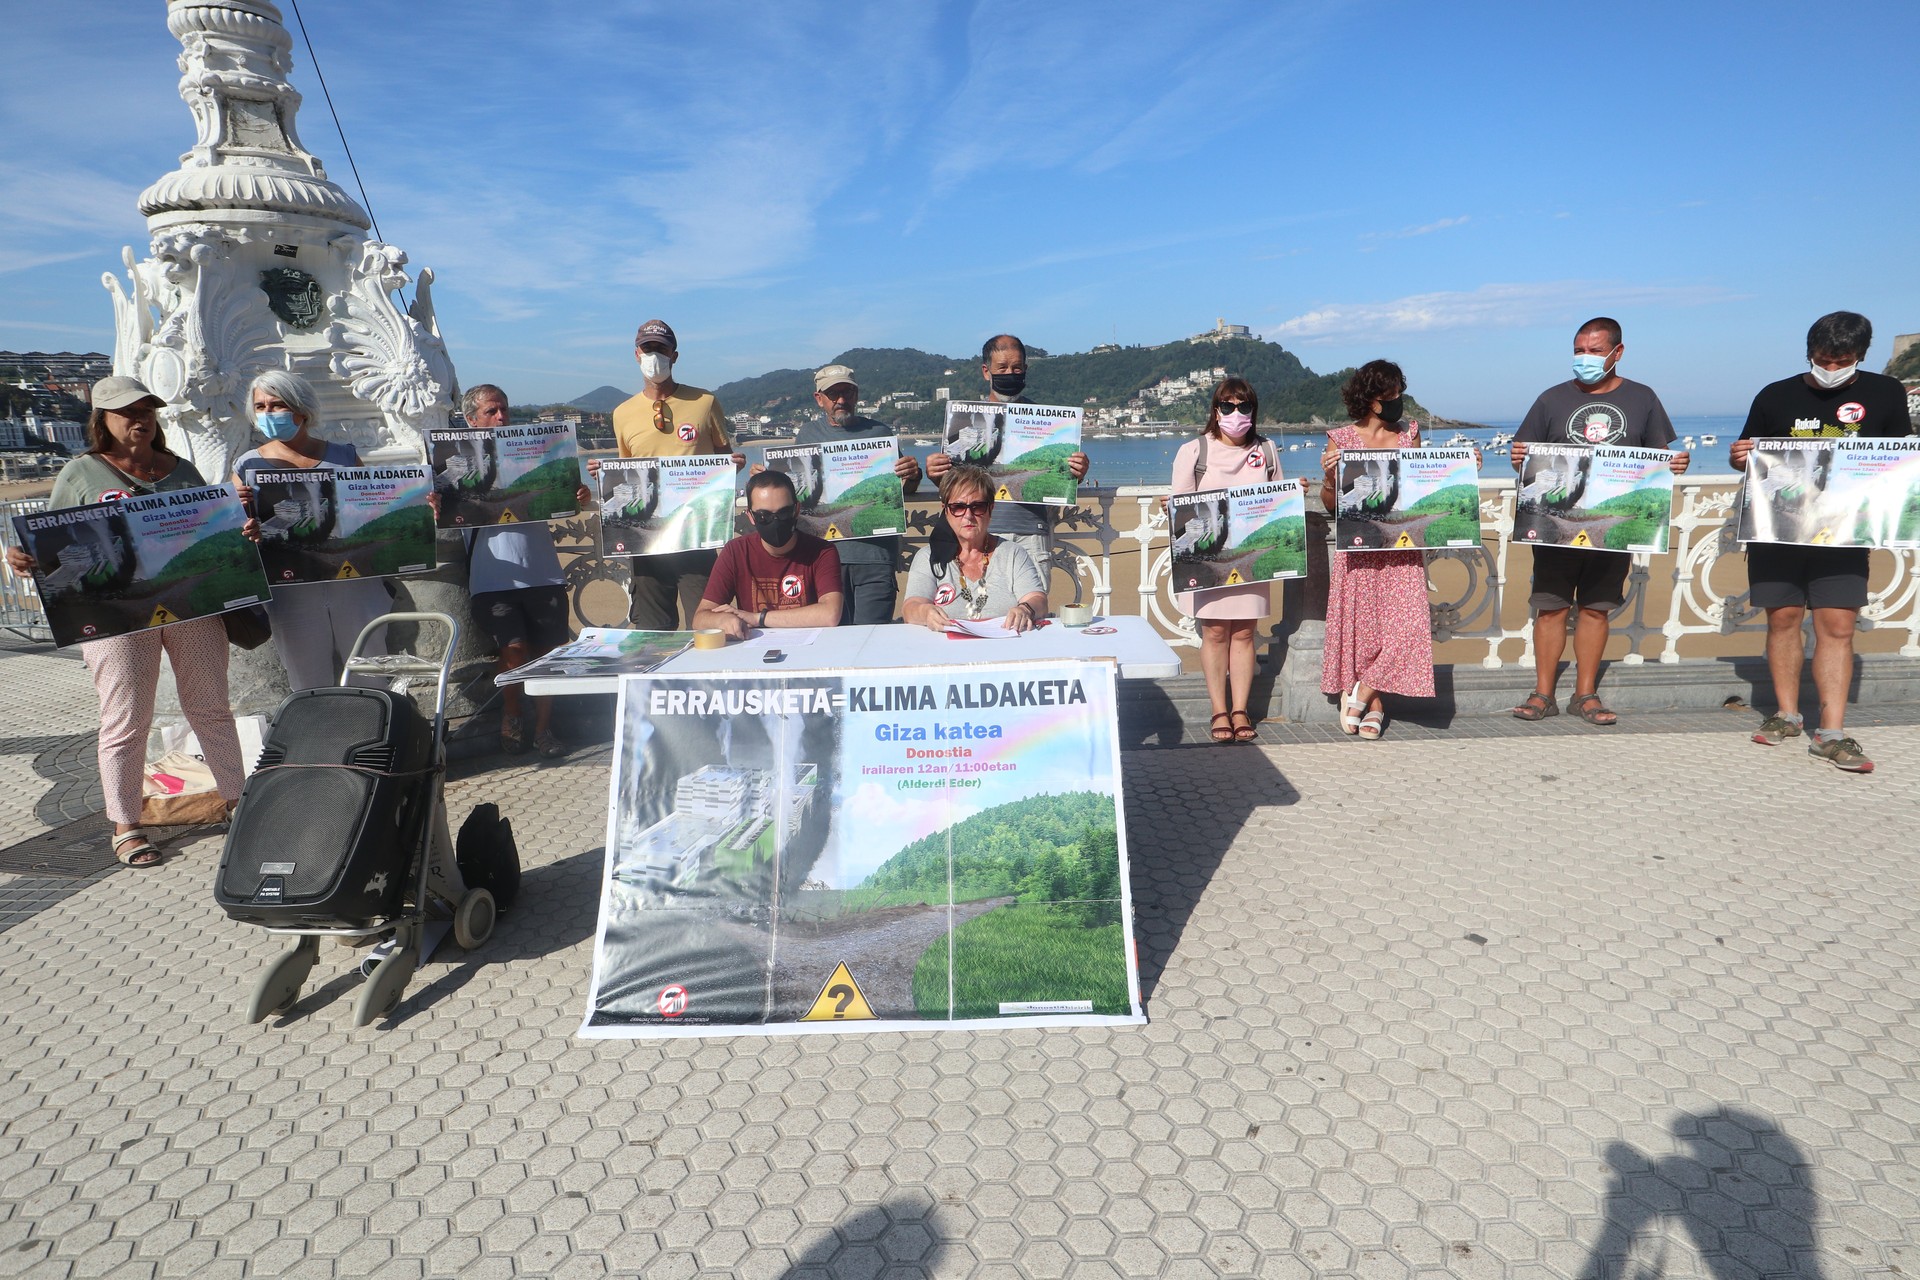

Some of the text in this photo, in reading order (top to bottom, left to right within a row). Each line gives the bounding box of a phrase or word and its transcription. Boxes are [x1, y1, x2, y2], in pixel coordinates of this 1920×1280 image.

[1008, 407, 1034, 416] KLIMA
[1036, 408, 1076, 418] ALDAKETA
[1795, 418, 1820, 430] Rukula
[496, 429, 524, 438] KLIMA
[528, 425, 569, 436] ALDAKETA
[824, 444, 848, 454] KLIMA
[851, 440, 892, 451] ALDAKETA
[1838, 442, 1874, 450] KLIMA
[1430, 452, 1470, 460] ALDAKETA
[1596, 450, 1626, 458] KLIMA
[661, 459, 686, 468] KLIMA
[688, 458, 730, 466] ALDAKETA
[337, 471, 370, 480] KLIMA
[374, 470, 424, 479] ALDAKETA
[1230, 488, 1255, 498] KLIMA
[1257, 483, 1296, 494] ALDAKETA
[124, 500, 164, 514] KLIMA
[169, 487, 229, 507] ALDAKETA
[142, 507, 198, 524] Giza katea
[849, 686, 935, 712] KLIMA
[946, 679, 1087, 709] ALDAKETA
[874, 721, 1004, 742] Giza katea
[906, 746, 972, 758] Donostia
[862, 764, 914, 775] irailaren
[897, 776, 982, 790] (Alderdi Eder)
